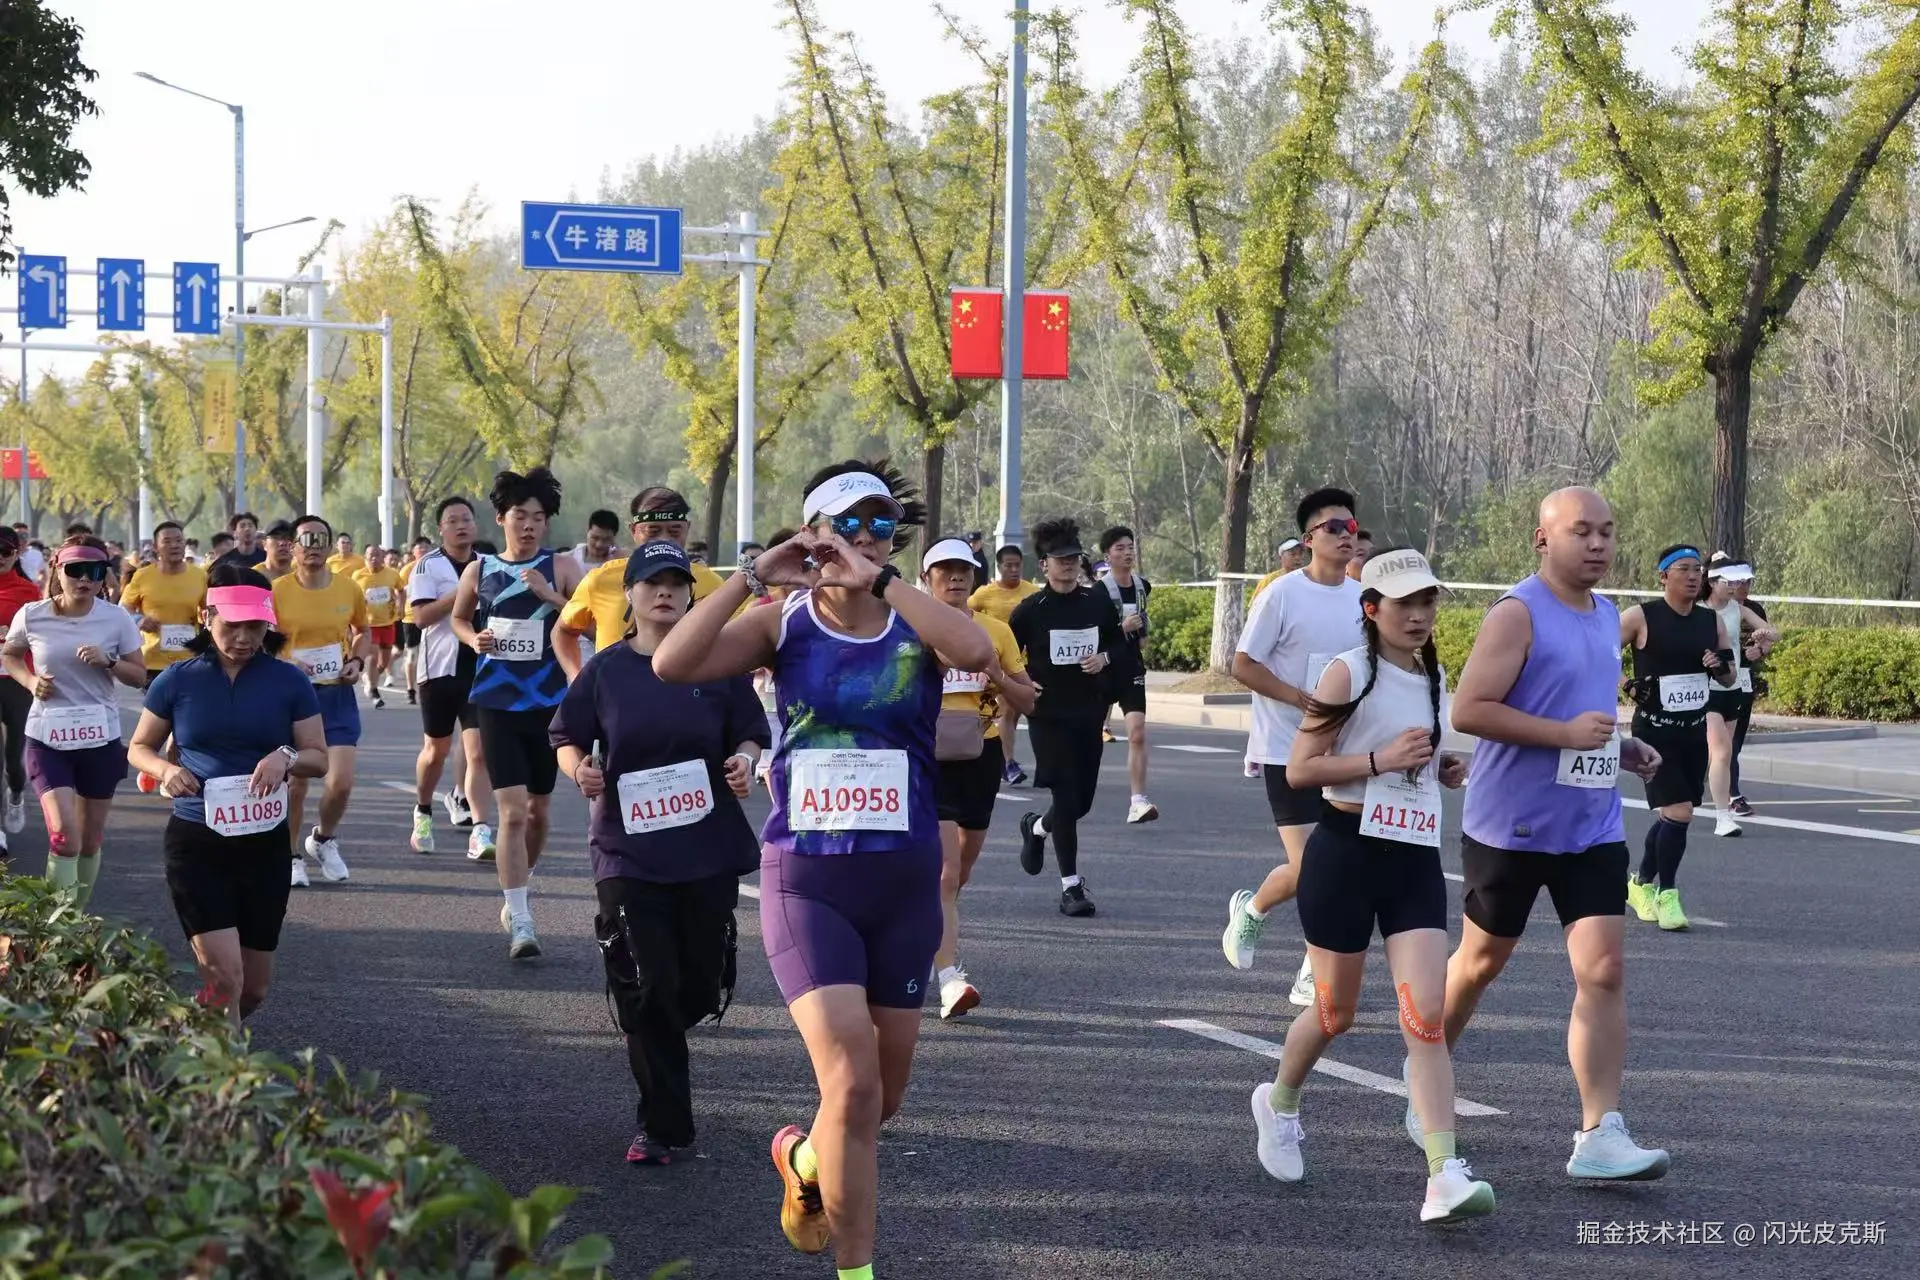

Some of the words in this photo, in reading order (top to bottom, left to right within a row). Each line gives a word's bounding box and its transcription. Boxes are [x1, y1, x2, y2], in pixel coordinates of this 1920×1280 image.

[564, 224, 649, 253] 牛渚路
[1056, 644, 1094, 657] A1778
[1668, 690, 1705, 704] A3444
[49, 725, 105, 742] A11651
[1570, 756, 1617, 776] A7387
[213, 800, 282, 825] A11089
[631, 789, 706, 821] A11098
[801, 787, 900, 813] A10958
[1370, 803, 1436, 834] A11724
